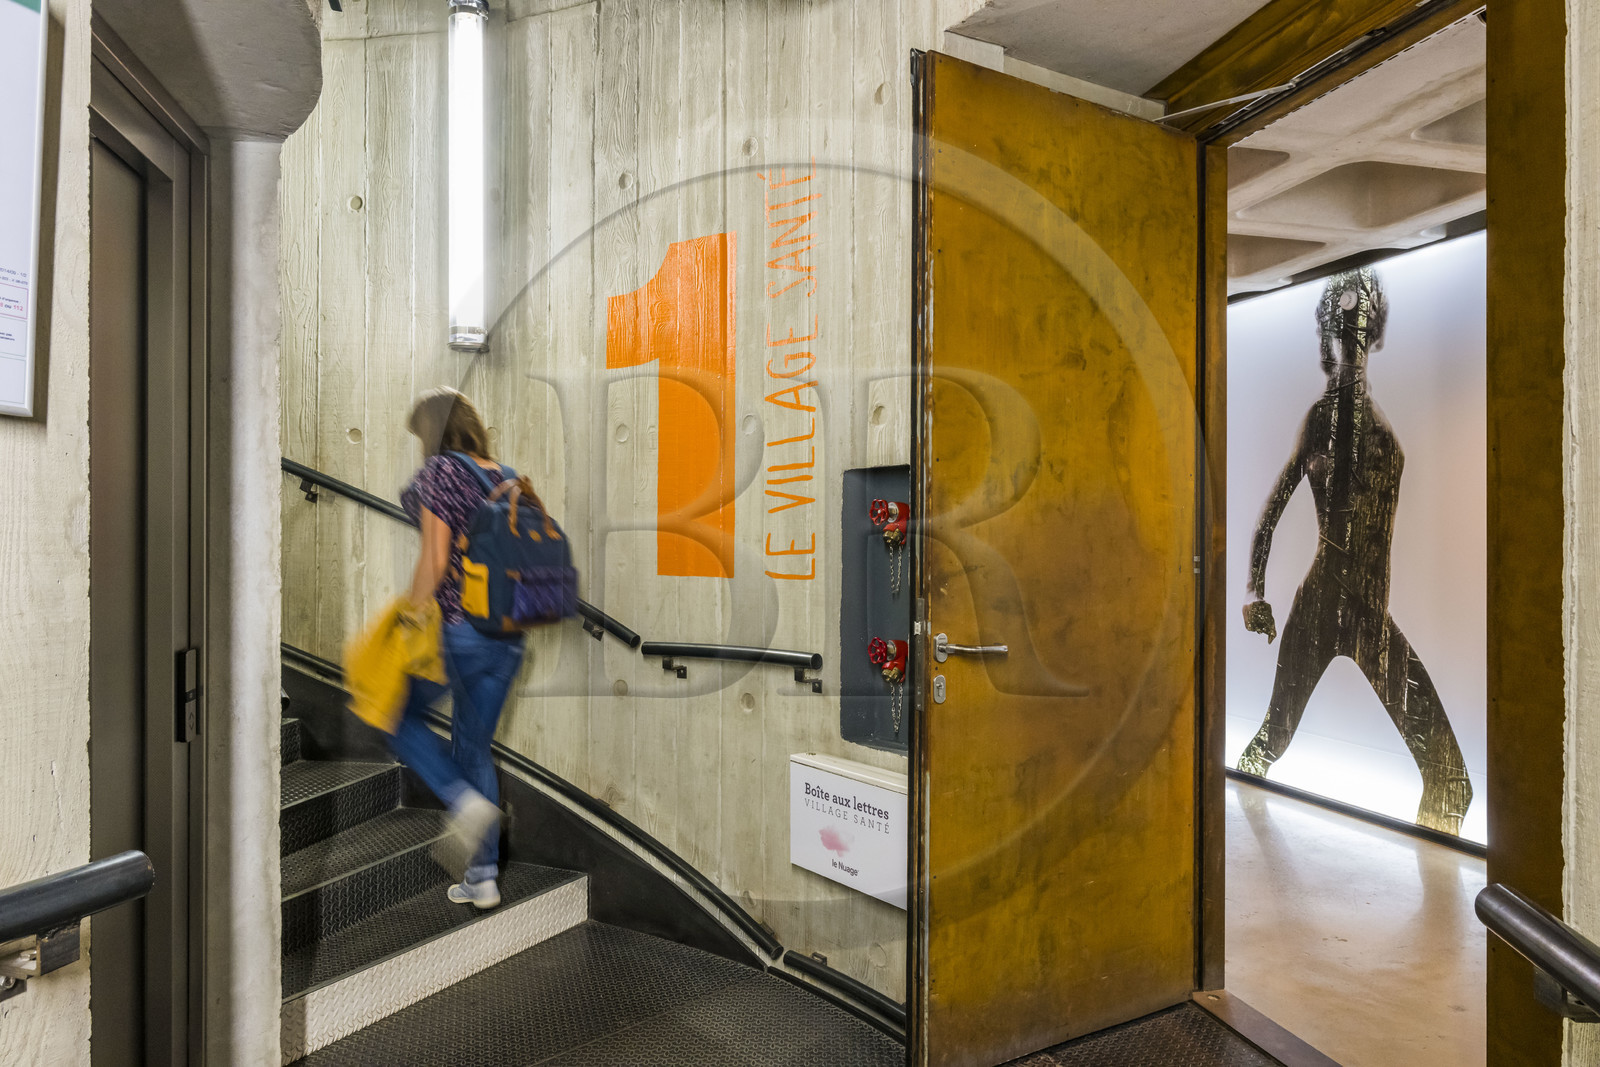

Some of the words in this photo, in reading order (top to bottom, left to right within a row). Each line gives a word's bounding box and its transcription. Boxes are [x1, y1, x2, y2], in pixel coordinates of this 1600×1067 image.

[757, 155, 823, 298] SANTÉ
[606, 230, 737, 578] 1
[764, 314, 819, 513] VILLAGE
[765, 532, 816, 580] LE
[804, 782, 830, 801] Boîte
[832, 794, 851, 808] aux
[853, 796, 889, 820] lettres
[804, 798, 848, 820] VILLAGE
[853, 814, 890, 834] SANTÉ
[831, 859, 838, 868] le
[838, 861, 858, 876] Nuage
